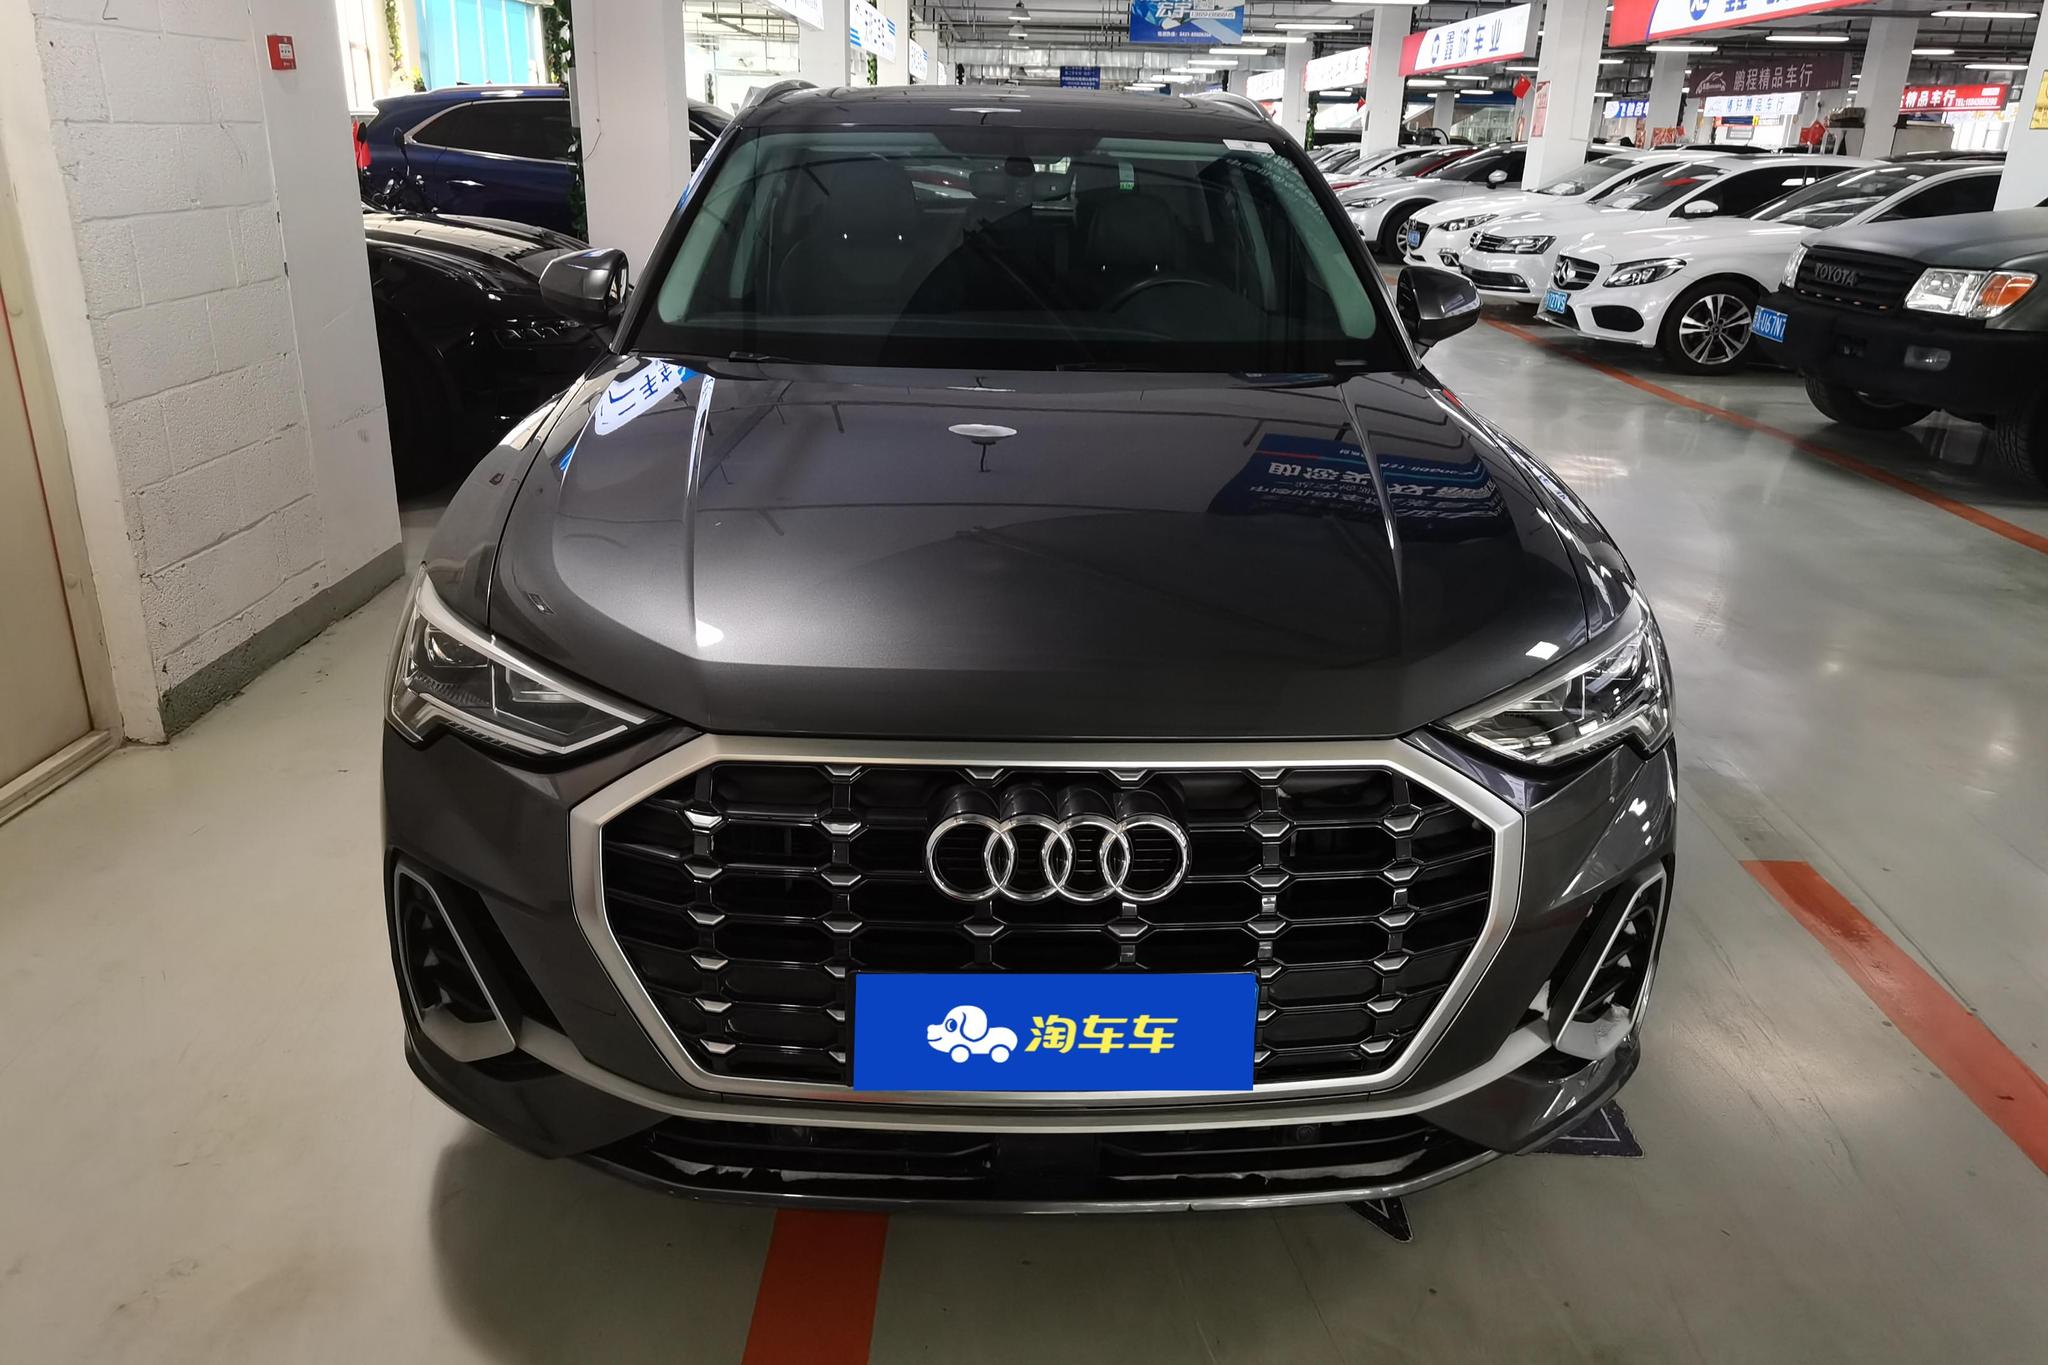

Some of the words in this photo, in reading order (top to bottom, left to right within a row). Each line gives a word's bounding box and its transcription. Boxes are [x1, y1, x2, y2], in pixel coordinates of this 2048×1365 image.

[1733, 63, 1813, 92] 鹏程精品车行
[1900, 89, 1956, 108] 精品车行
[1814, 262, 1857, 287] TOYOTA
